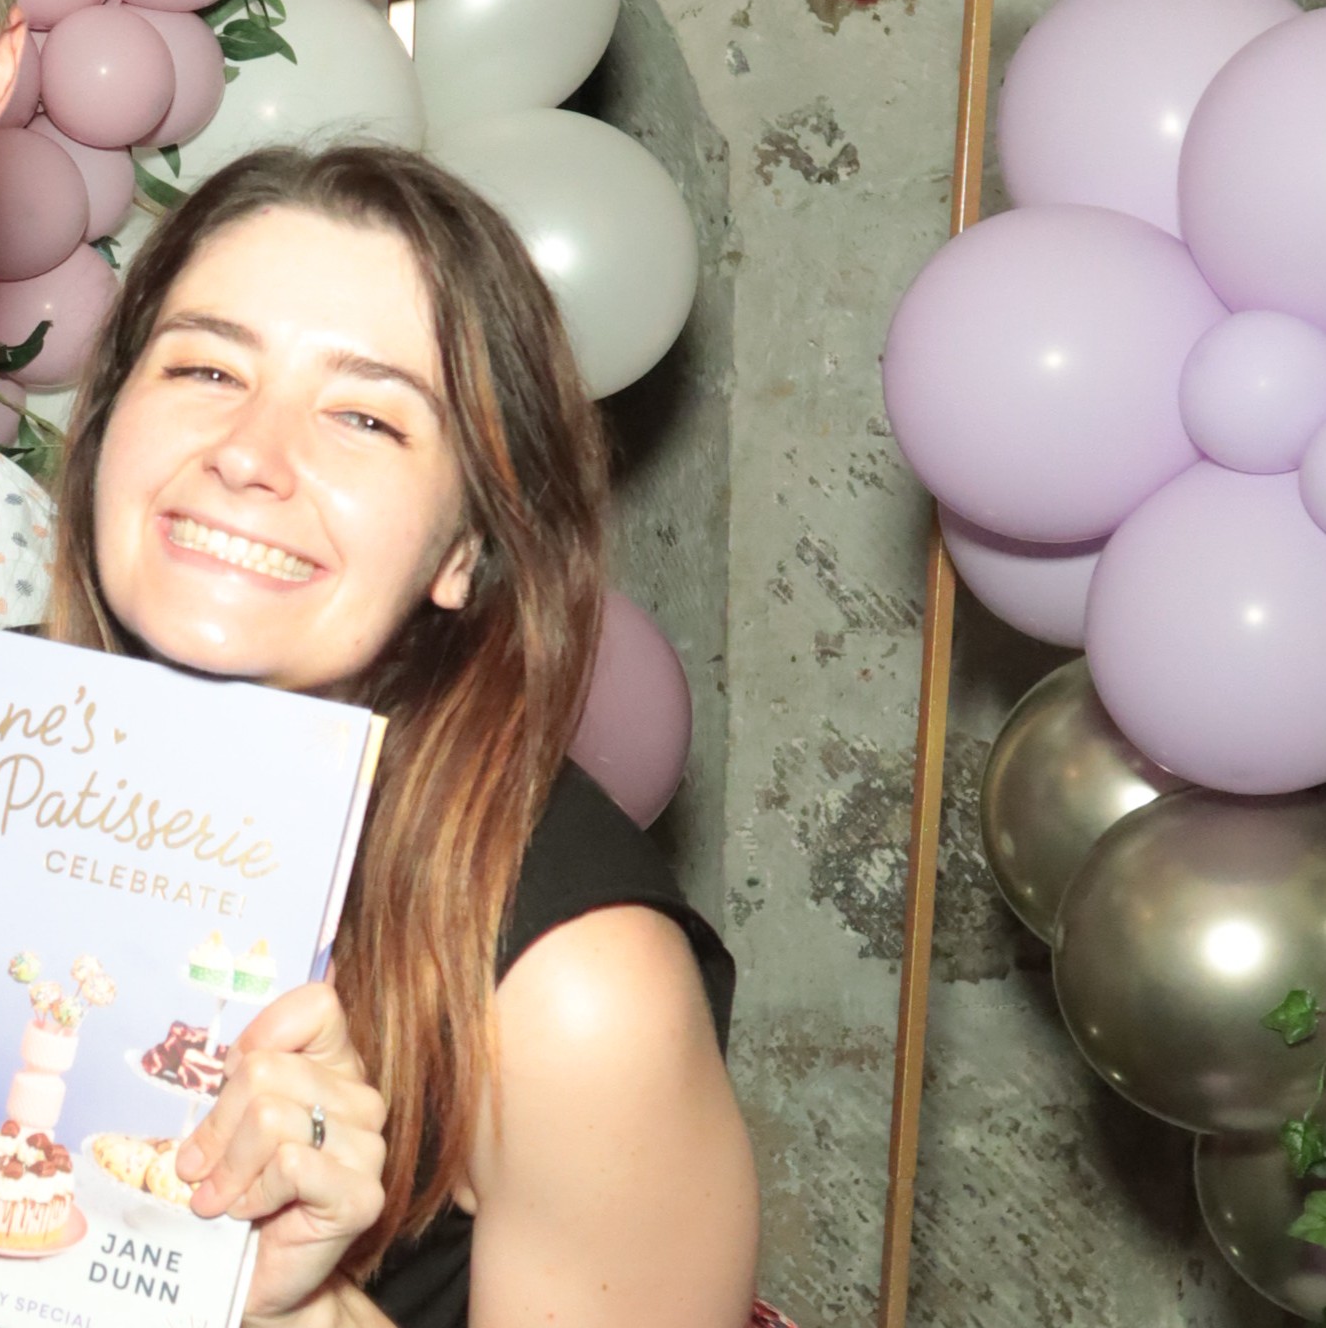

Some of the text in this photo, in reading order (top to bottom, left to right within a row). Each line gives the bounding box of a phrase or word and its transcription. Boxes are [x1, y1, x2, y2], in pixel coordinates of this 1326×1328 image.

[44, 849, 248, 919] CELEBRATE!
[100, 1232, 183, 1274] JANE
[87, 1260, 180, 1306] DUNN
